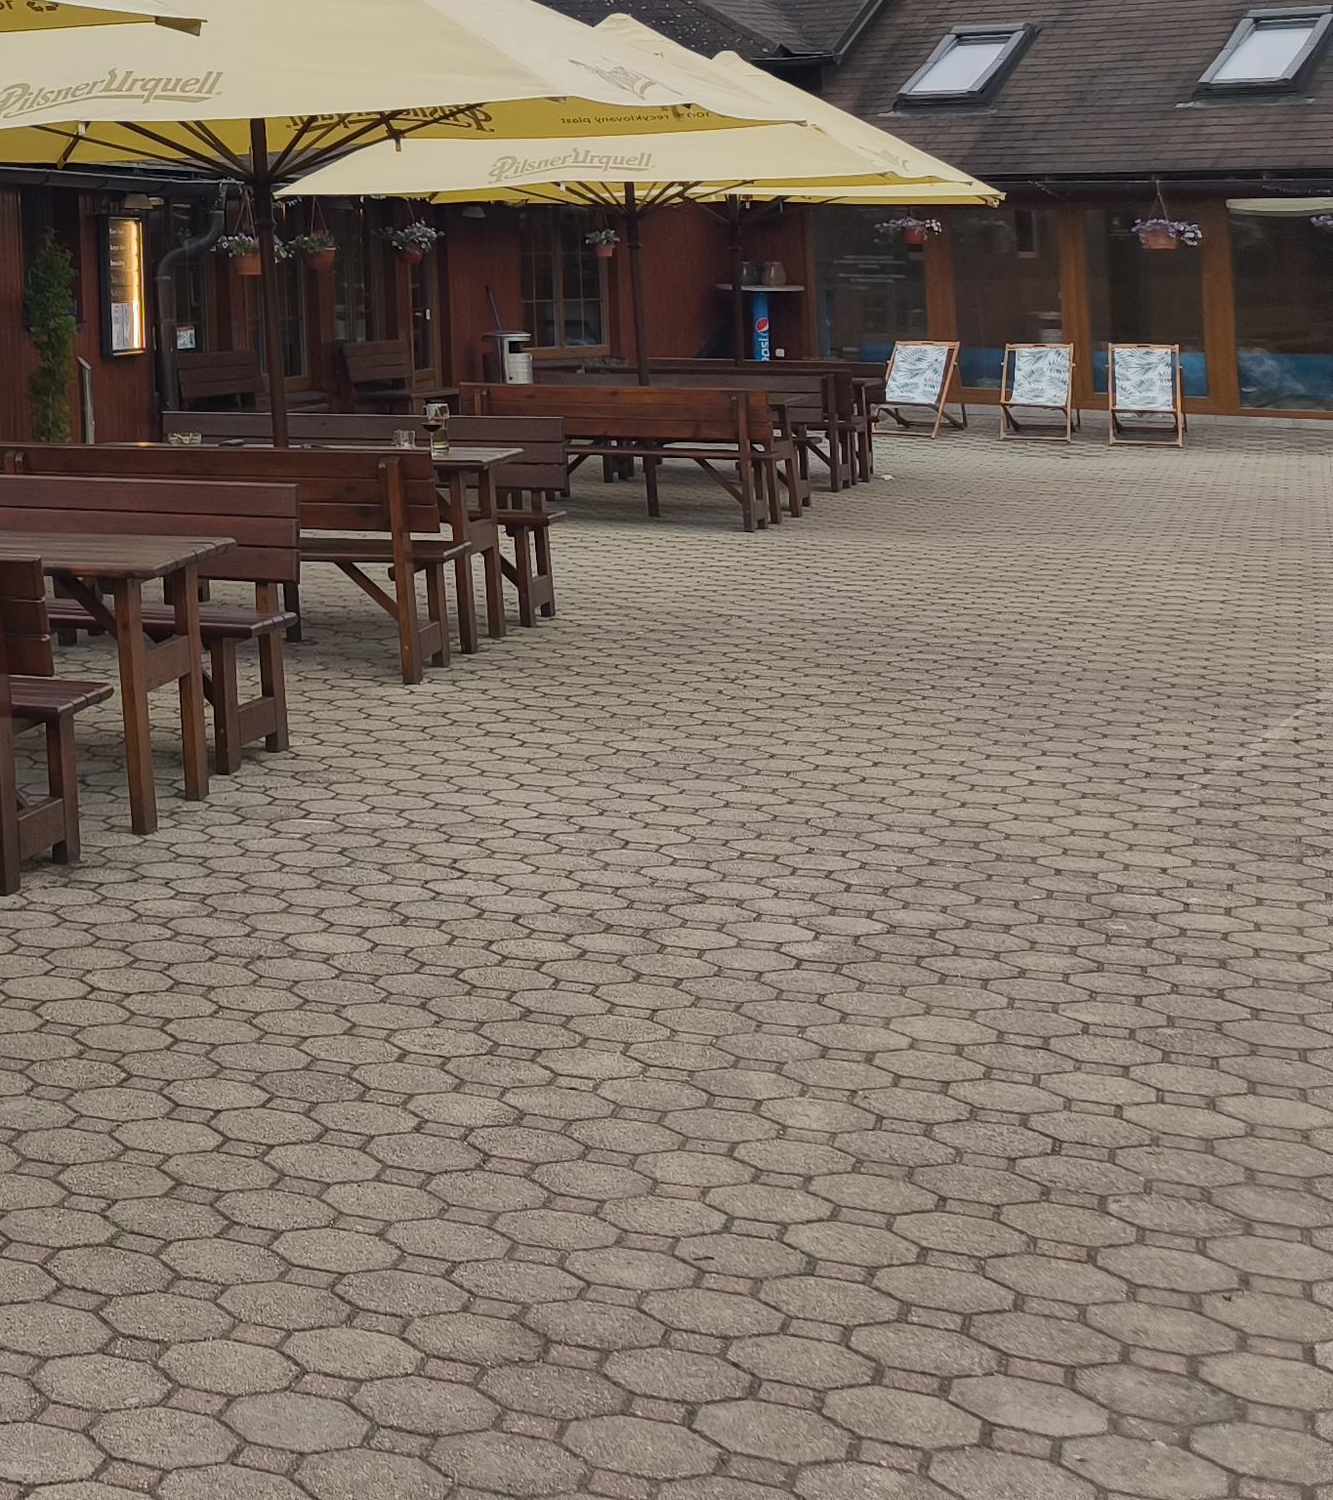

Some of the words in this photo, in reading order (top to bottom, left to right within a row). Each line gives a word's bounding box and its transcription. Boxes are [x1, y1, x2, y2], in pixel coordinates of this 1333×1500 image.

[99, 67, 224, 105] Urquell
[487, 154, 573, 185] Pilsner
[567, 147, 653, 172] Urquell
